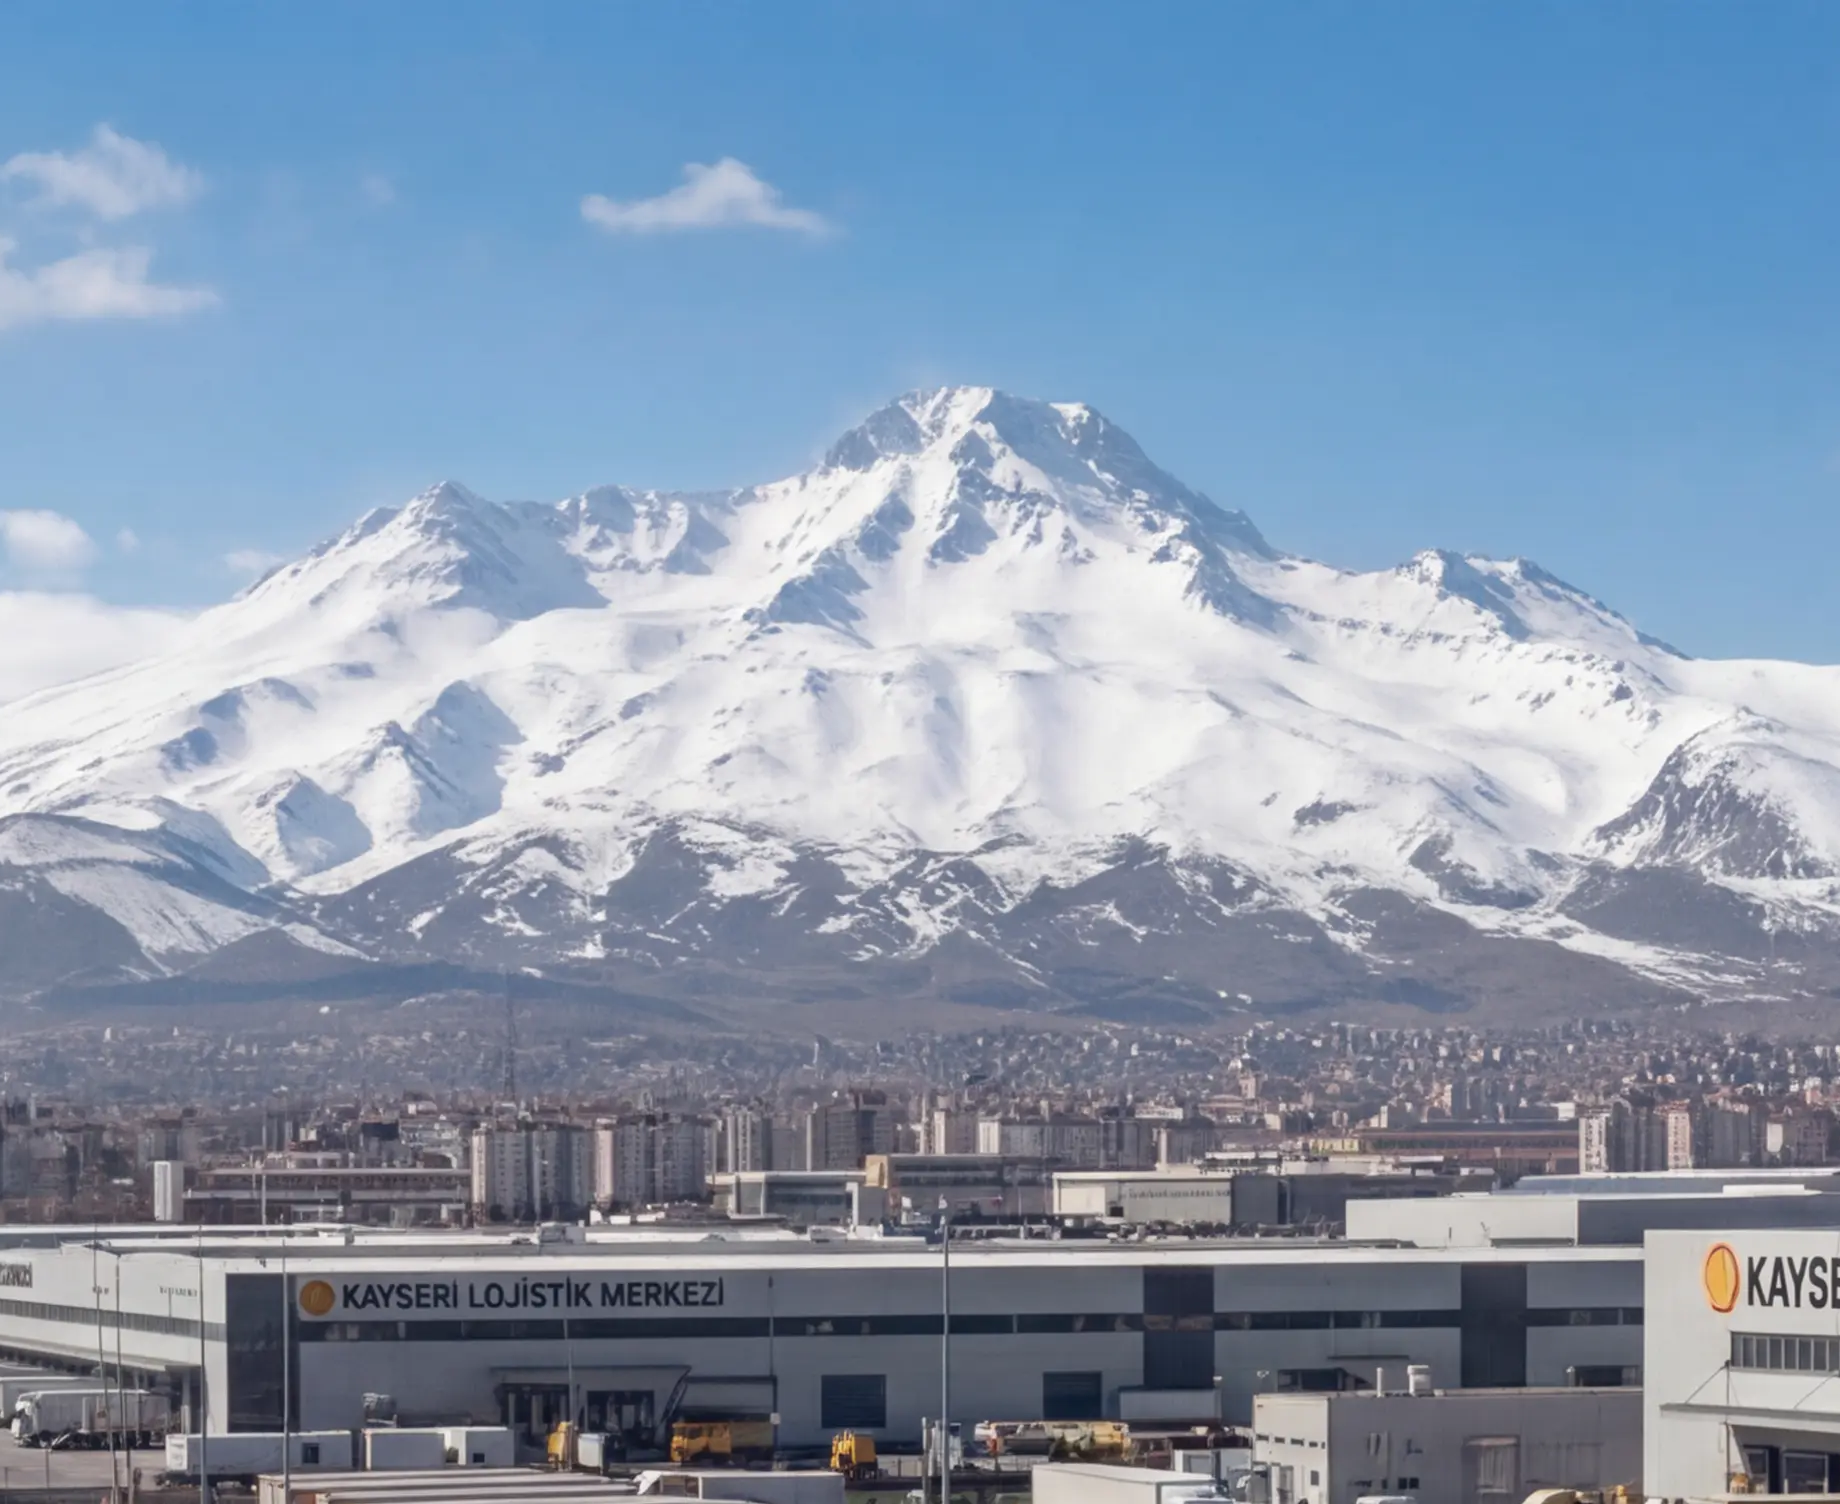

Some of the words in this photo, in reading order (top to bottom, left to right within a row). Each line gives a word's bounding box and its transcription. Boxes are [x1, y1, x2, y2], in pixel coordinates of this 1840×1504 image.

[342, 1277, 458, 1309] KAYSERİ
[468, 1276, 593, 1309] LOJİSTİK
[600, 1277, 724, 1307] MERKEZİ
